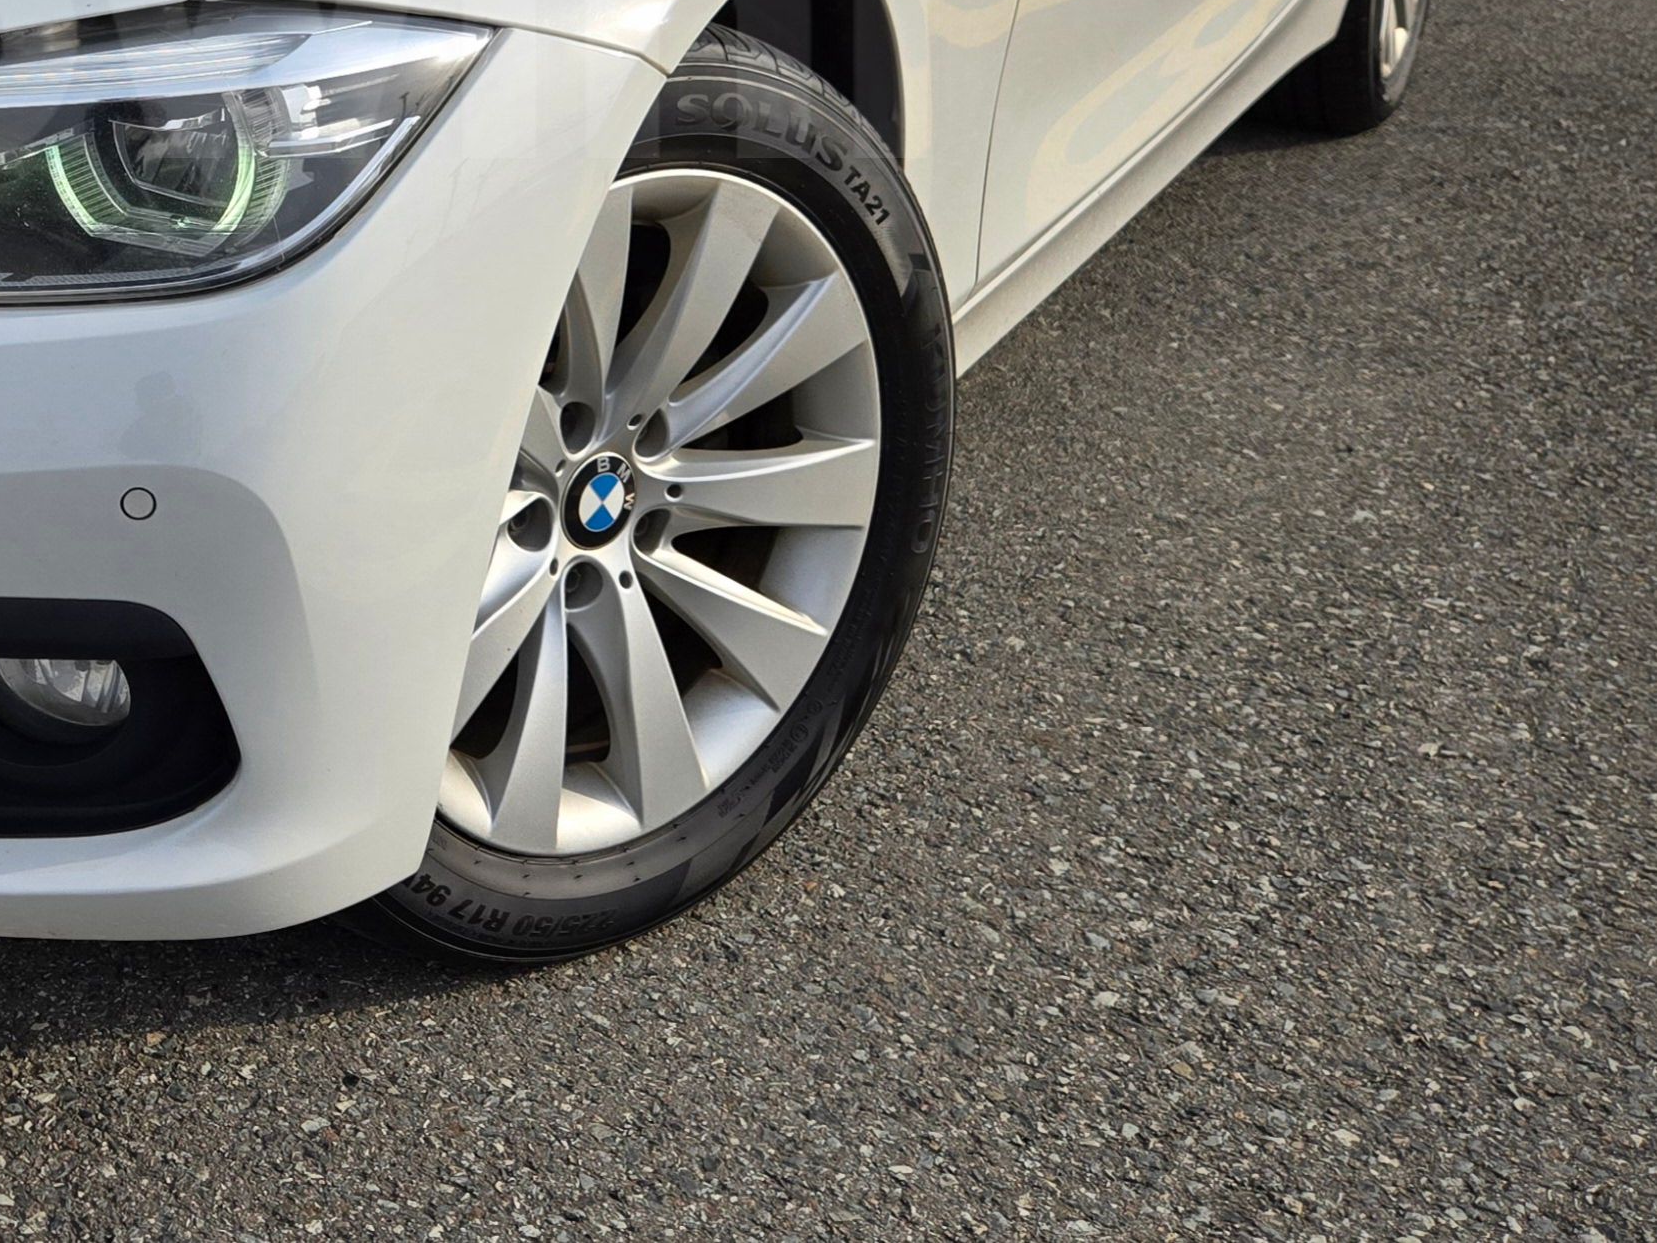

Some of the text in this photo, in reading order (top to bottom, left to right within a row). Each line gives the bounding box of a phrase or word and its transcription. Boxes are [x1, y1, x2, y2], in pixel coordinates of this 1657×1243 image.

[676, 91, 891, 225] SOLUS TA21
[597, 456, 635, 511] BMW
[447, 898, 511, 934] R17
